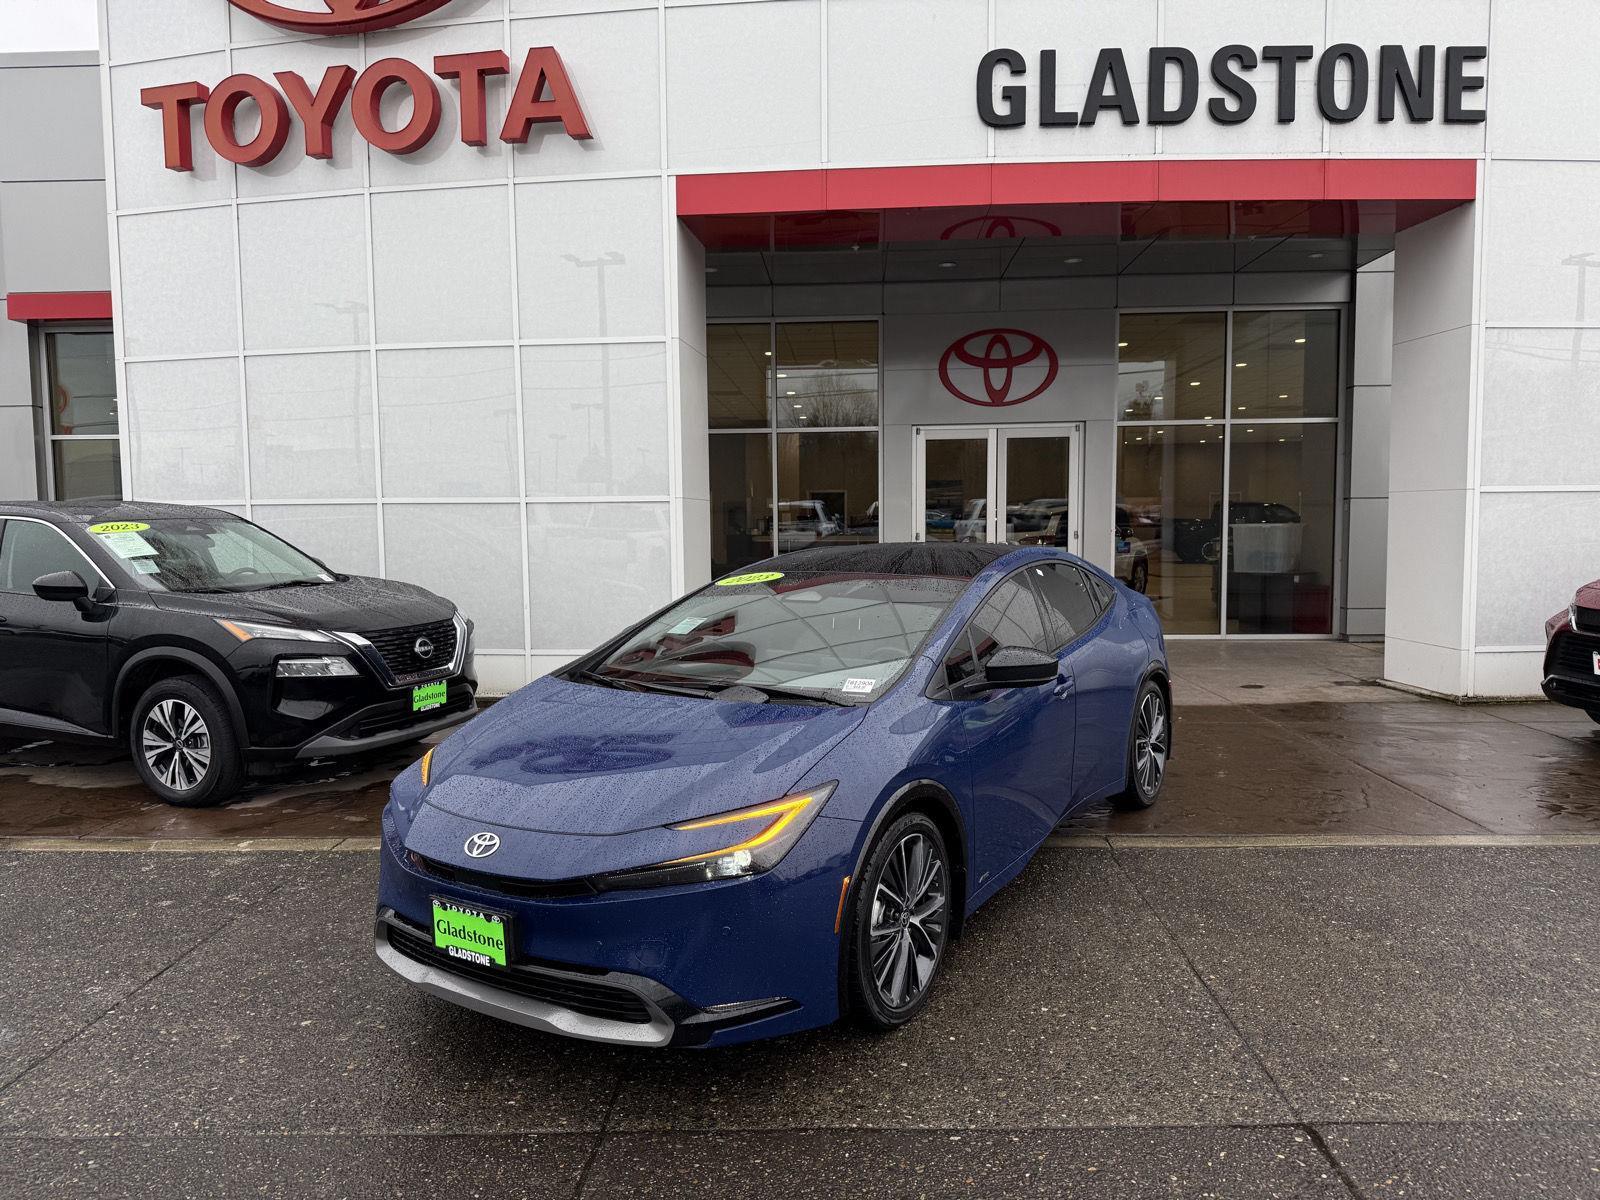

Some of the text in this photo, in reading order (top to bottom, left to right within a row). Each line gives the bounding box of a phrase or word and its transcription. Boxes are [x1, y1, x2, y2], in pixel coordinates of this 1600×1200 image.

[976, 43, 1487, 128] GLADSTONE
[140, 46, 593, 172] TOYOTA
[100, 523, 139, 532] 2023
[413, 691, 445, 703] Gladstone
[446, 903, 485, 919] TOYOTA
[436, 919, 503, 950] Gladstone
[448, 945, 490, 966] GLADSTONE
